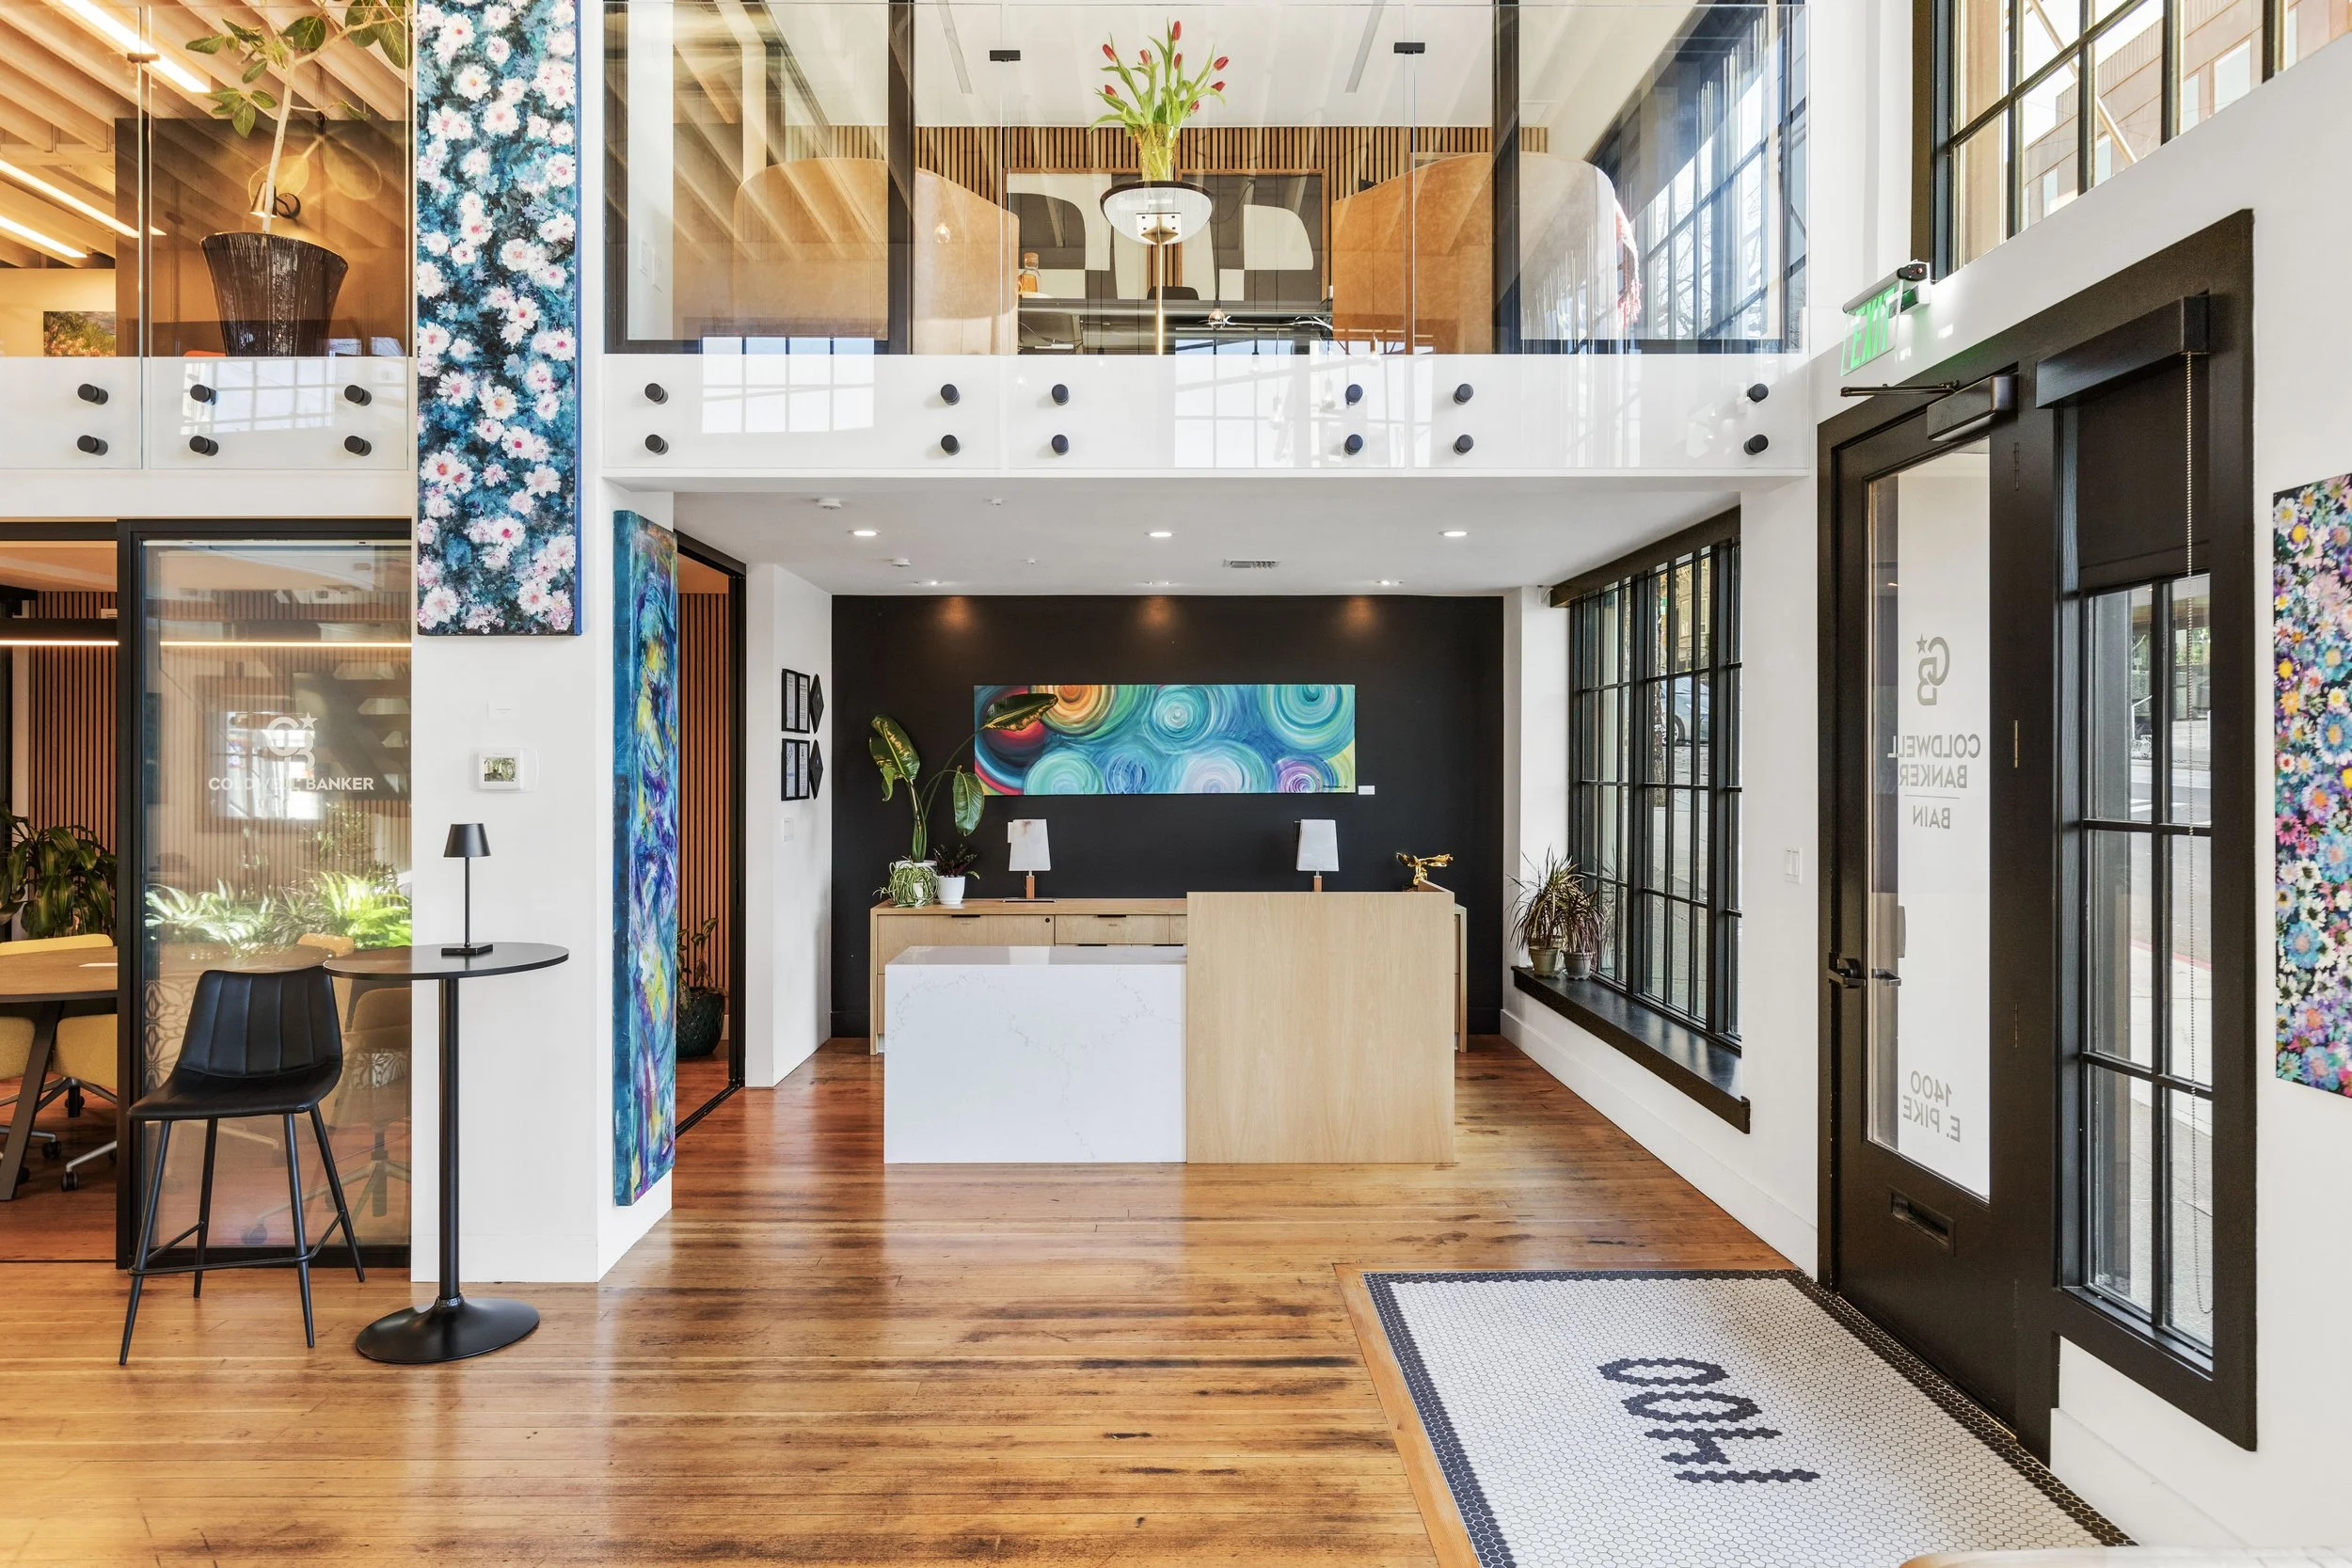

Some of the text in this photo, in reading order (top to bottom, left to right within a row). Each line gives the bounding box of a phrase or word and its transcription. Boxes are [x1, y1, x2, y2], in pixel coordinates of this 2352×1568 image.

[1850, 287, 1895, 369] EXIT
[306, 777, 374, 791] BANKER
[1597, 1357, 1821, 1483] 1400
